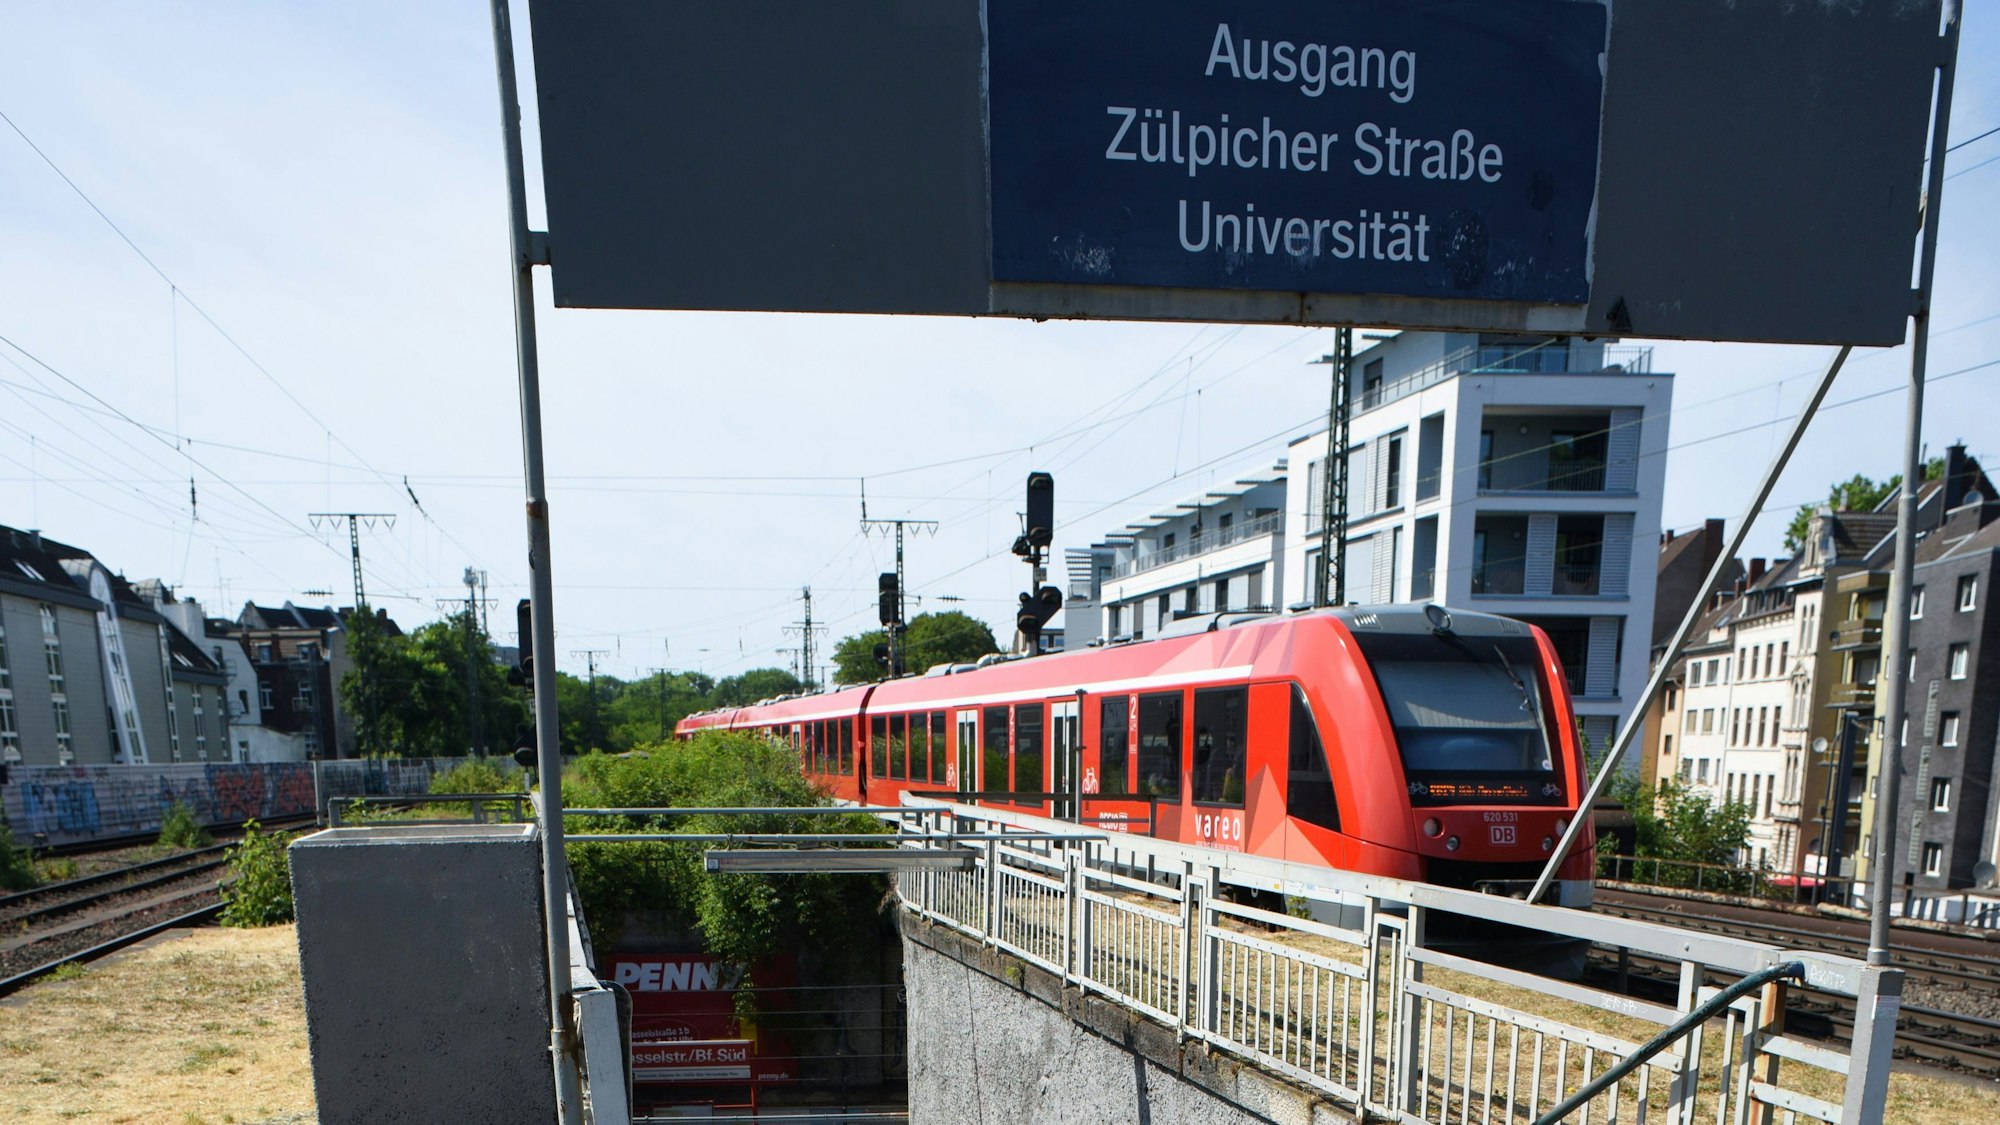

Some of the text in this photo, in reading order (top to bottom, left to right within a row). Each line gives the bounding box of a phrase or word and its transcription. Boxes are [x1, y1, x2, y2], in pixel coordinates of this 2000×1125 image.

[1205, 23, 1416, 103] Ausgang
[1105, 106, 1504, 183] Zülpicher Straße
[1178, 200, 1430, 262] Universität
[1131, 697, 1137, 719] 2
[1195, 814, 1241, 841] vareo
[1484, 812, 1518, 822] 620 531
[1492, 827, 1514, 842] DB
[717, 1048, 746, 1062] Süd
